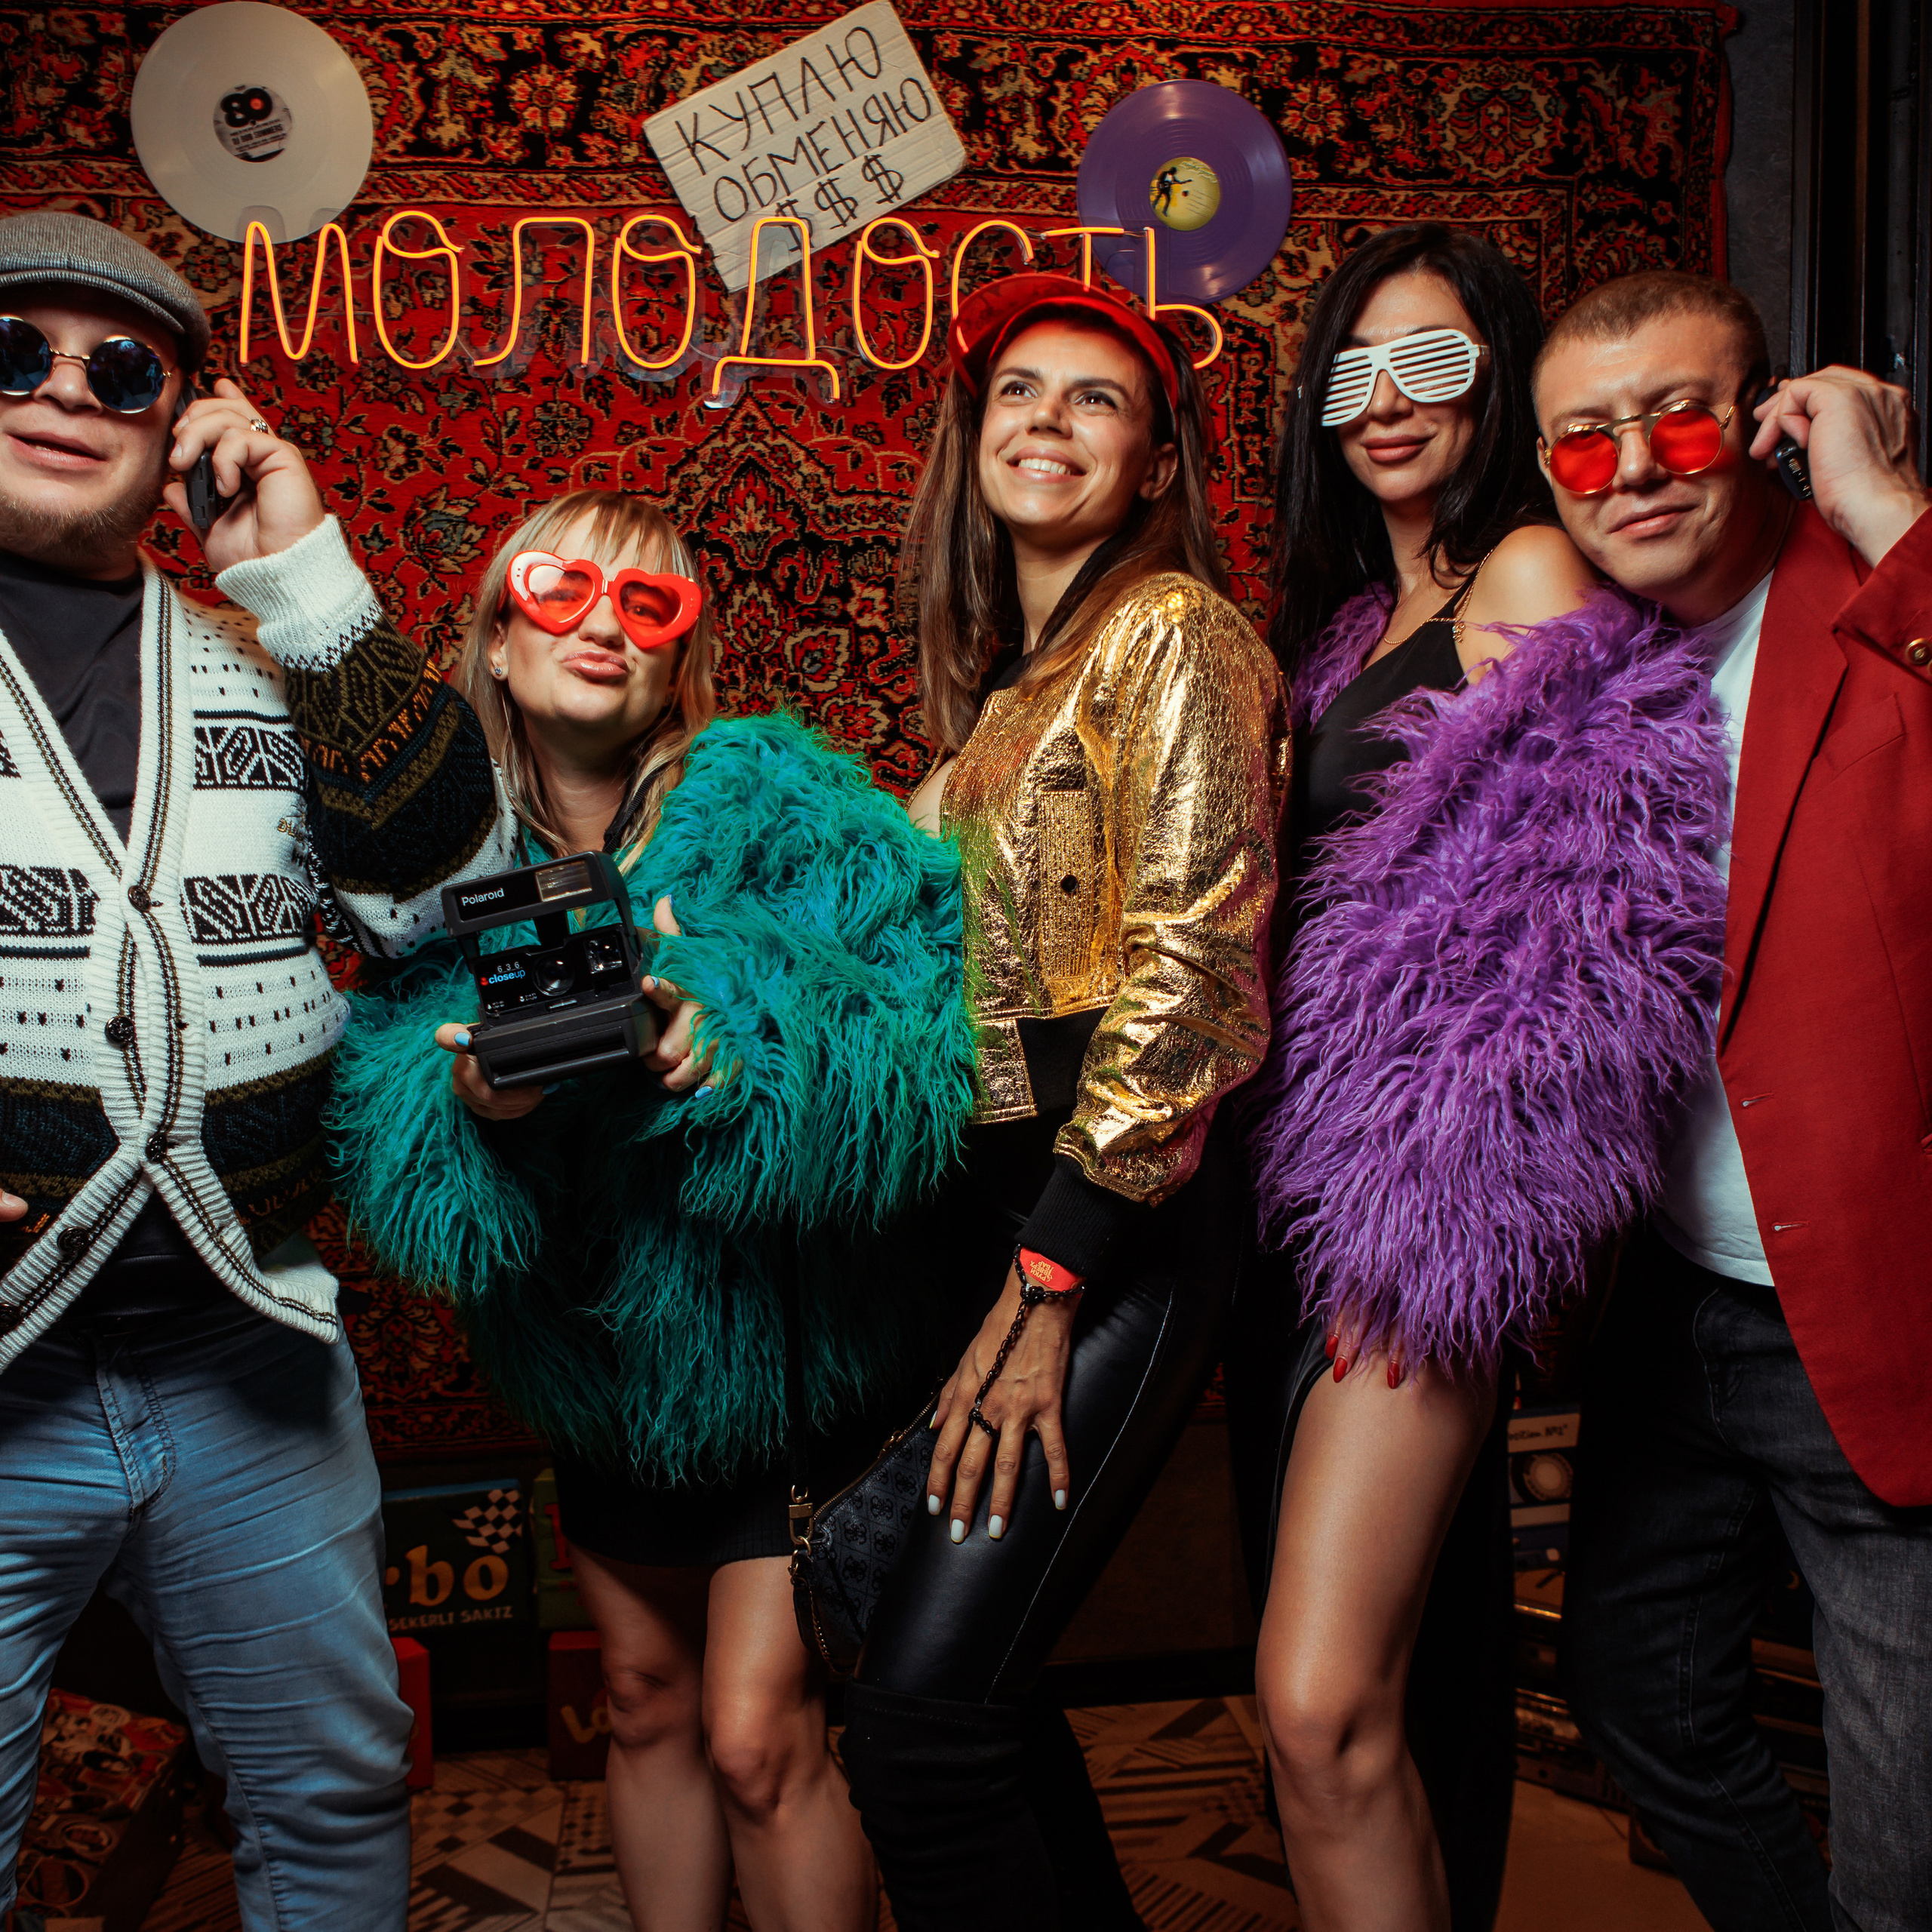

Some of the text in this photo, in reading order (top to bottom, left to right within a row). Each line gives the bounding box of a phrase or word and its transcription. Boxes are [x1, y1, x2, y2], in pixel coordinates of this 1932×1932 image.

[675, 26, 882, 176] КУПЛЮ
[713, 77, 931, 223] ОБМЕНЯЮ
[240, 210, 1223, 402] МОЛОДОСТЬ
[461, 887, 505, 906] Polaroid
[488, 969, 526, 984] closeup
[1029, 1260, 1049, 1275] ВВЕРХ
[1038, 1260, 1051, 1269] БАР
[1029, 1267, 1047, 1281] РУКИ
